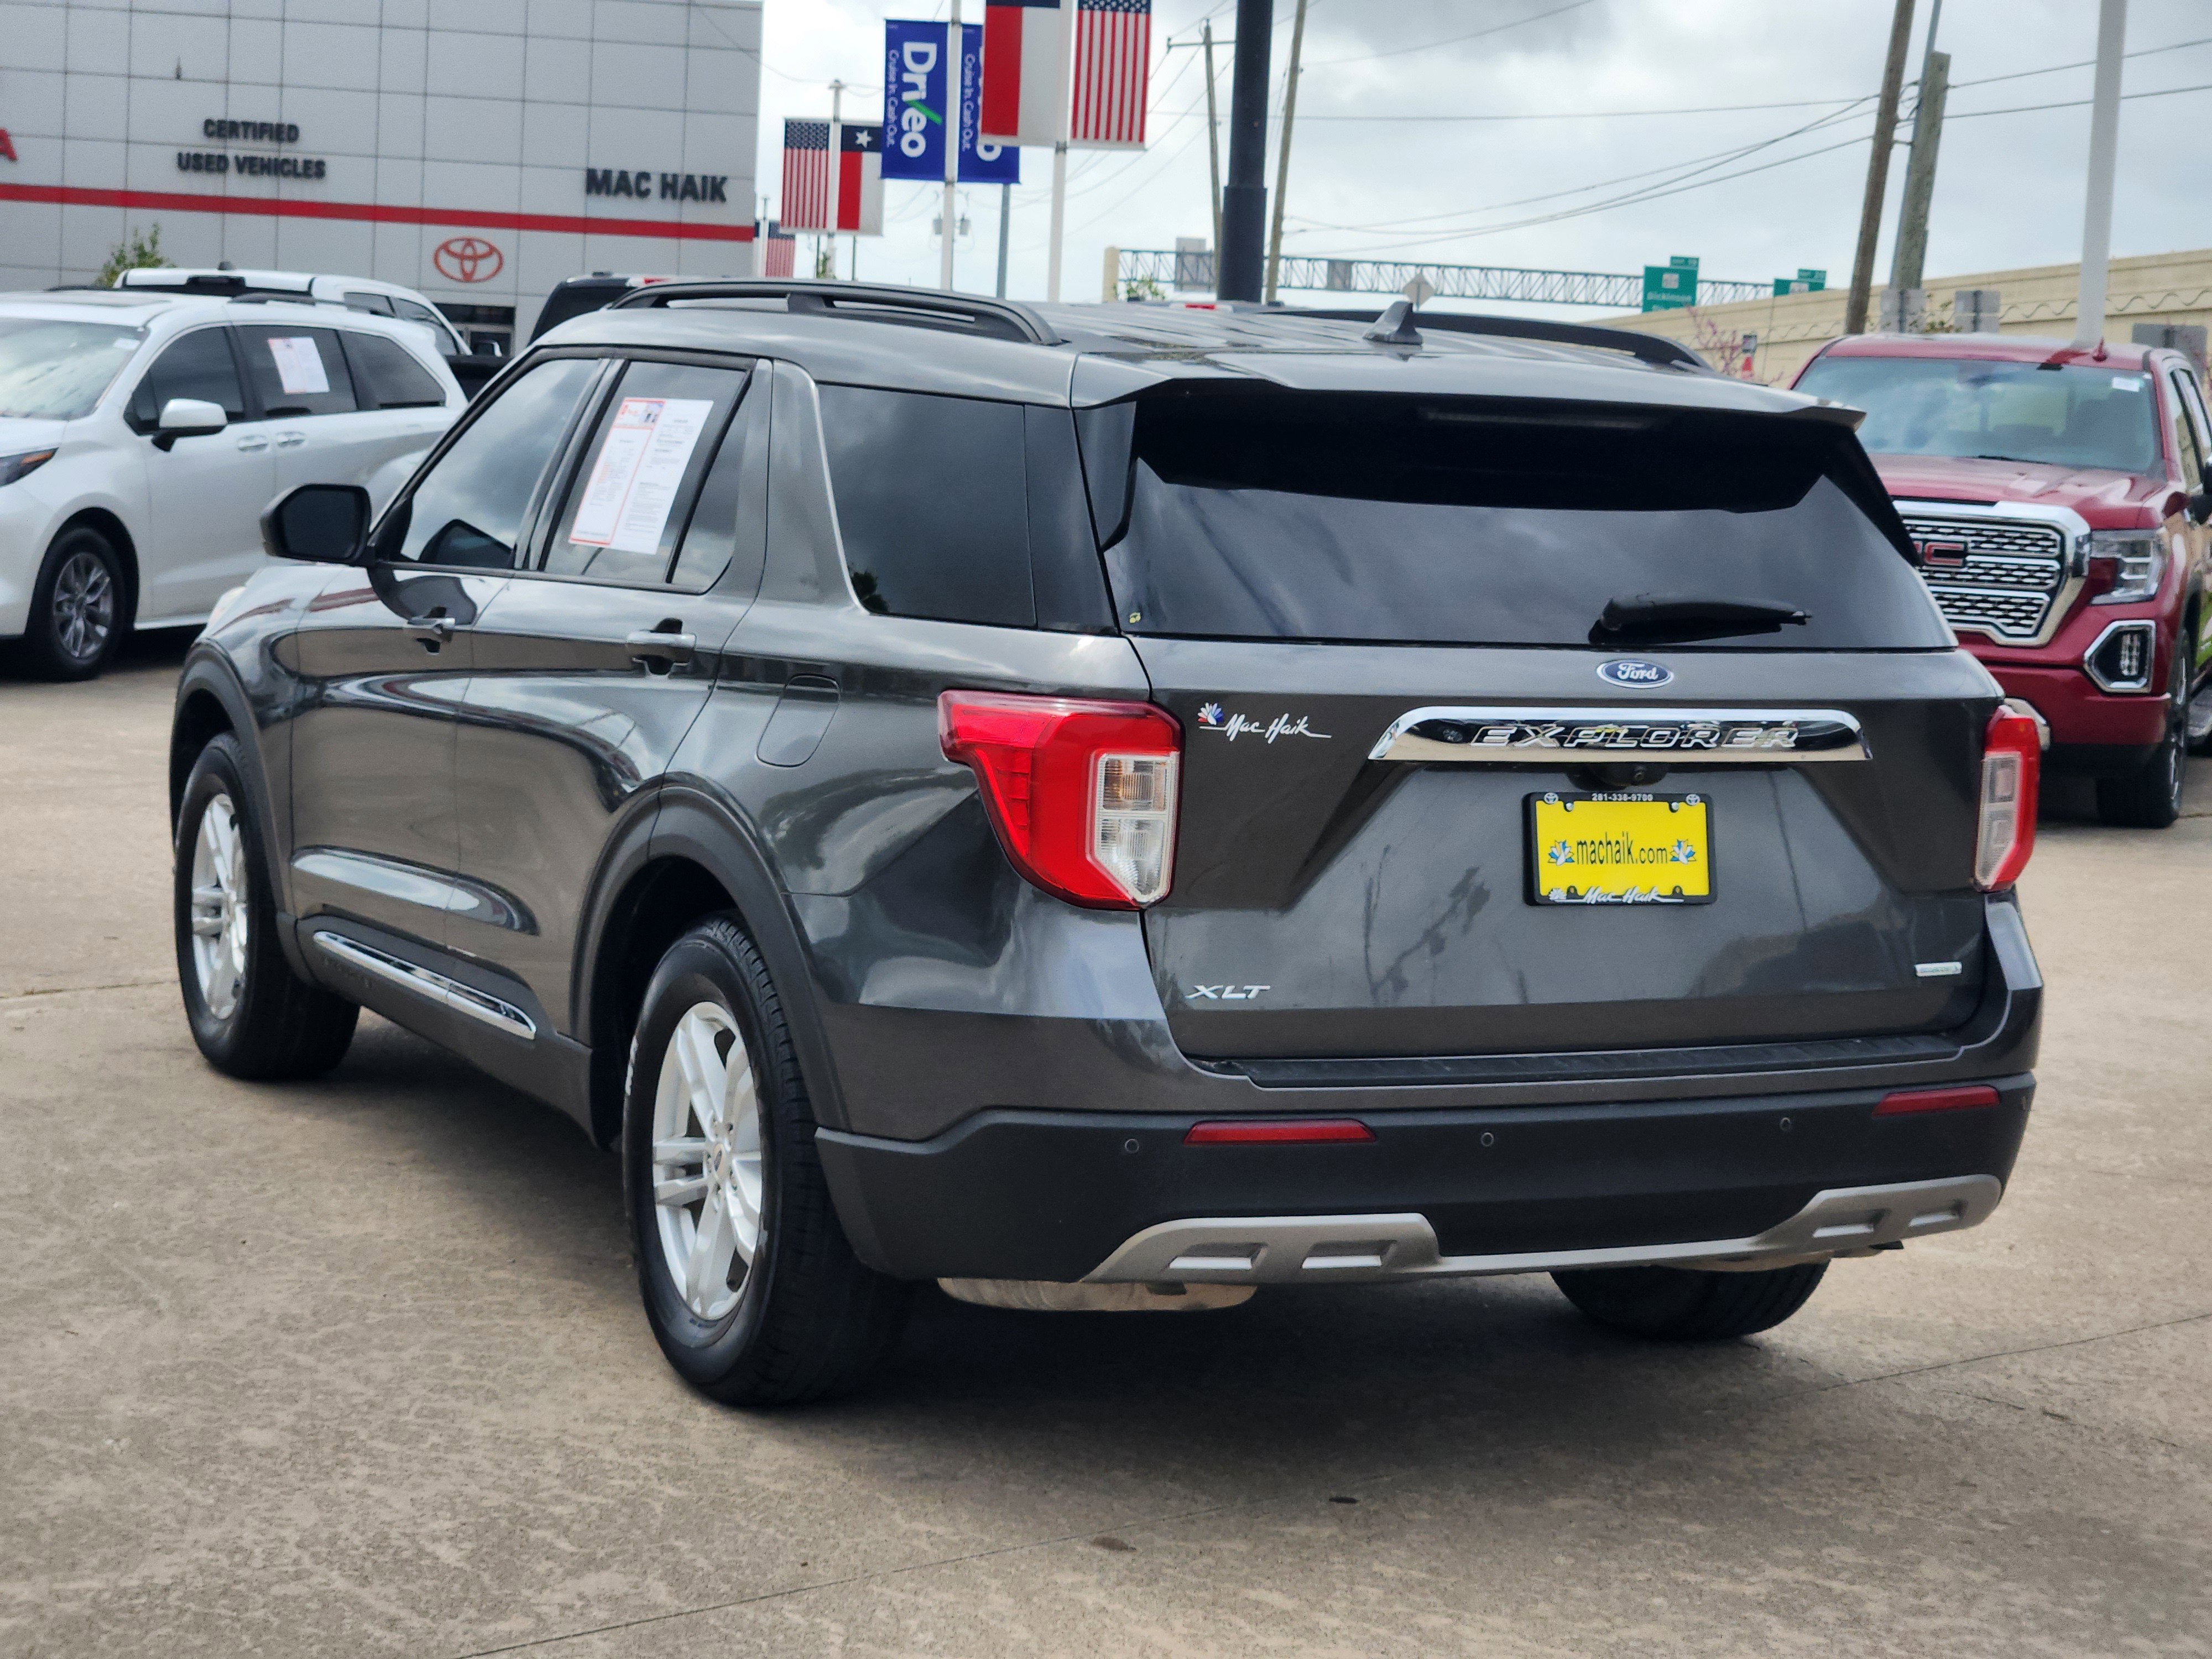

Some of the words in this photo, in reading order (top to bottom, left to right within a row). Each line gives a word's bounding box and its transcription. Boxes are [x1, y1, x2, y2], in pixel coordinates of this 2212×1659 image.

[204, 118, 300, 143] CERTIFIED
[177, 151, 229, 171] USED
[234, 154, 327, 179] VEHICLES
[586, 168, 651, 197] MAC
[660, 173, 728, 202] HAIK
[1616, 662, 1659, 680] Ford
[1199, 713, 1265, 741] Mac
[1265, 713, 1332, 744] Haik
[1469, 726, 1798, 748] EXPLORER
[1576, 831, 1668, 865] machaik.com
[1621, 886, 1684, 904] Haik
[1185, 985, 1271, 999] XLT
